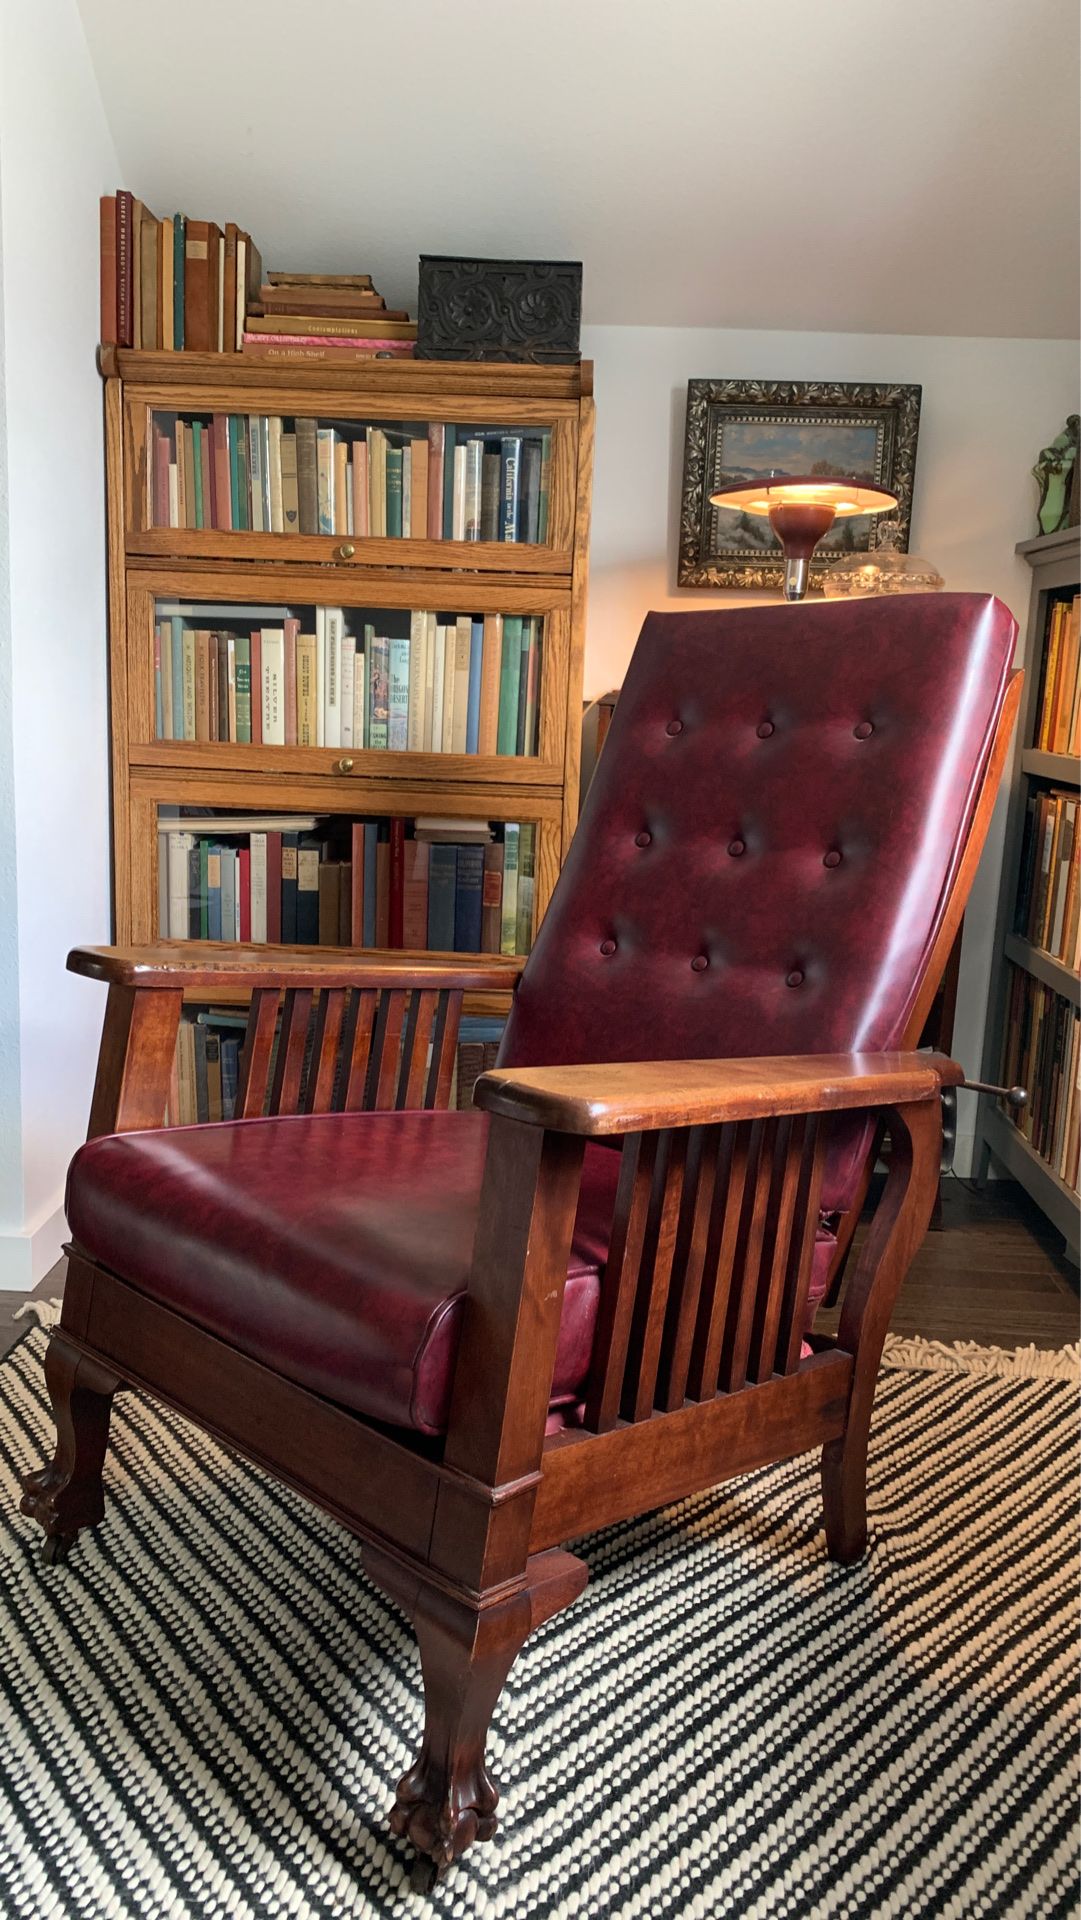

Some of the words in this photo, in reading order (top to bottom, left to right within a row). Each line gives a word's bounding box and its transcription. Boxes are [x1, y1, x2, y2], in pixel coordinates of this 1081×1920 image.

[307, 325, 358, 334] Contemplations
[287, 350, 304, 358] High
[306, 350, 325, 358] Shelf
[505, 457, 516, 500] California
[506, 509, 514, 519] the
[412, 656, 421, 701] JOURNALIST
